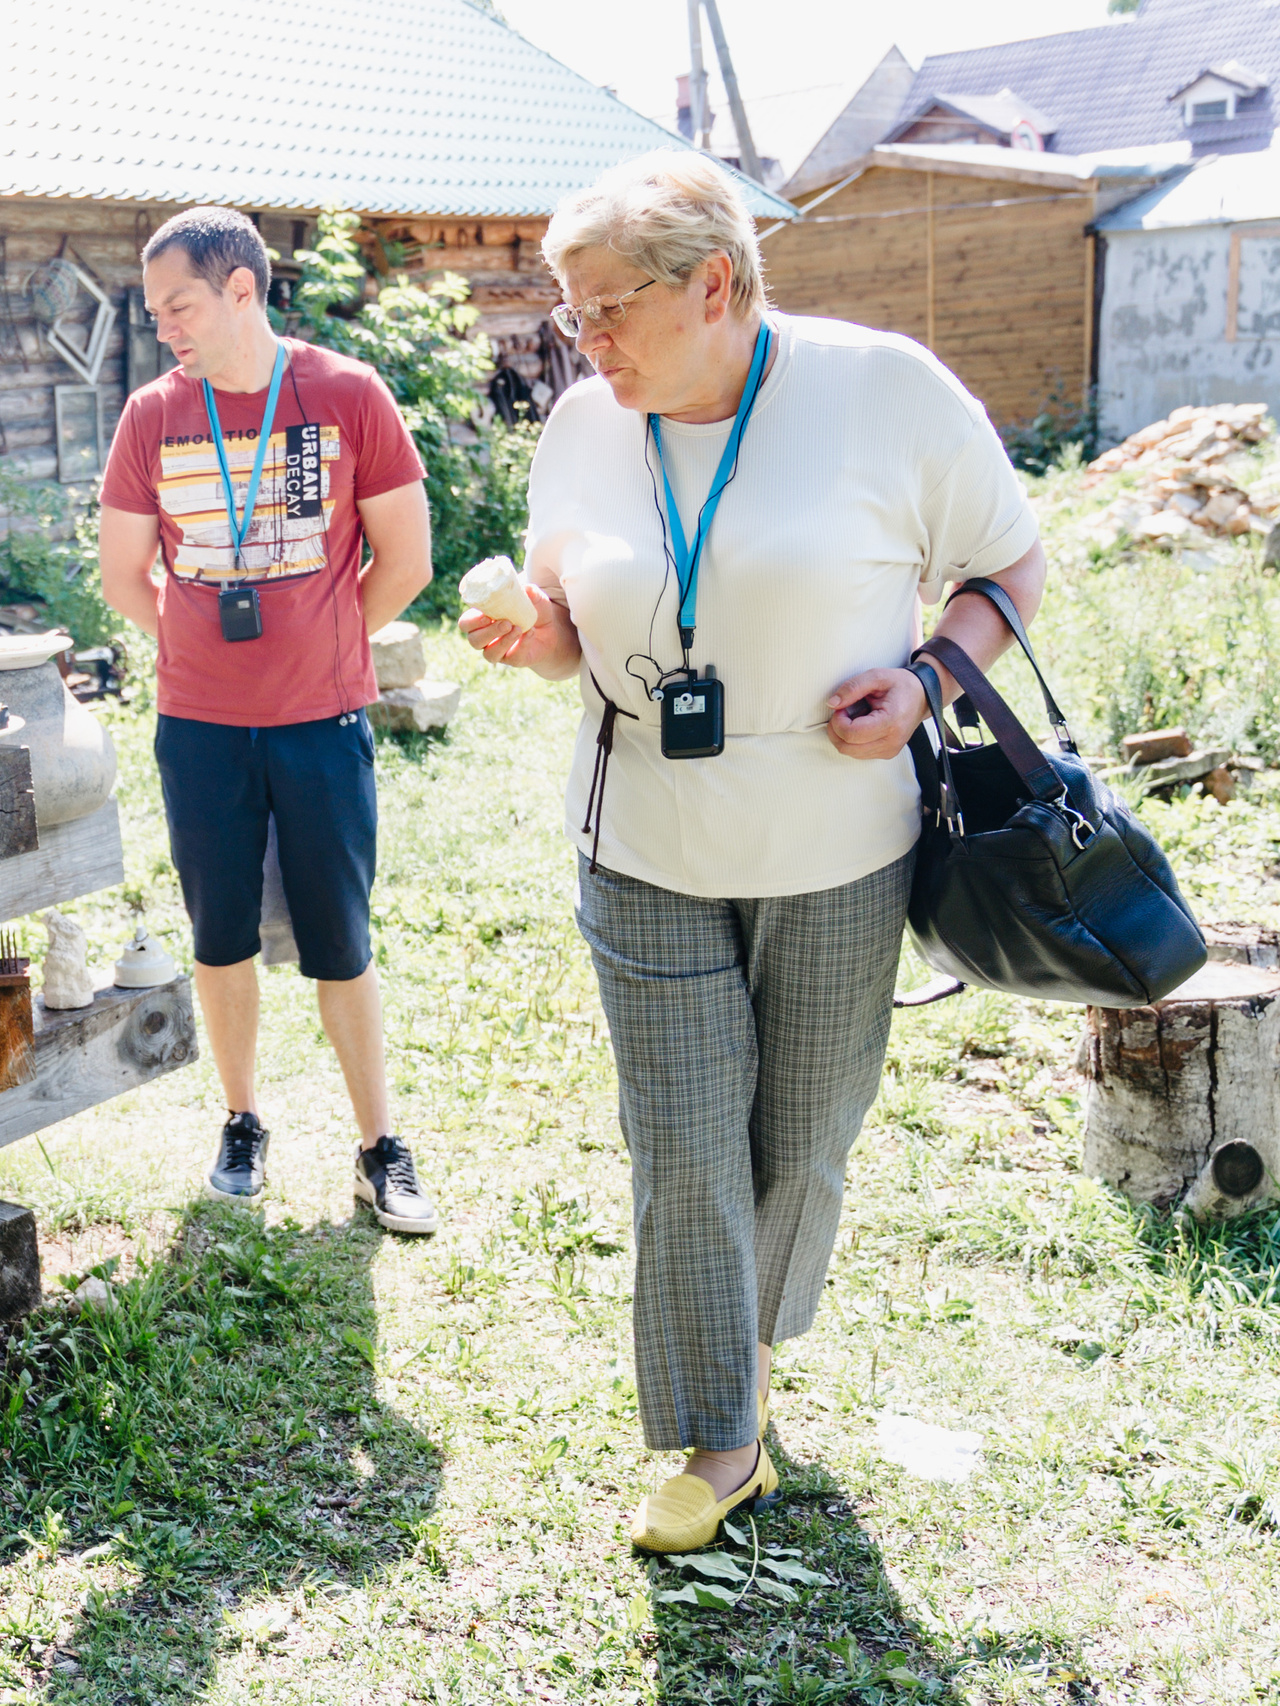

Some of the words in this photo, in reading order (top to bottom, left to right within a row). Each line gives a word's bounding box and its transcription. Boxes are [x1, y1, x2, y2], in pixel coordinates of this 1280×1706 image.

[158, 428, 272, 449] EMOLTIO
[301, 425, 319, 501] URBAN
[286, 454, 302, 516] DECAY
